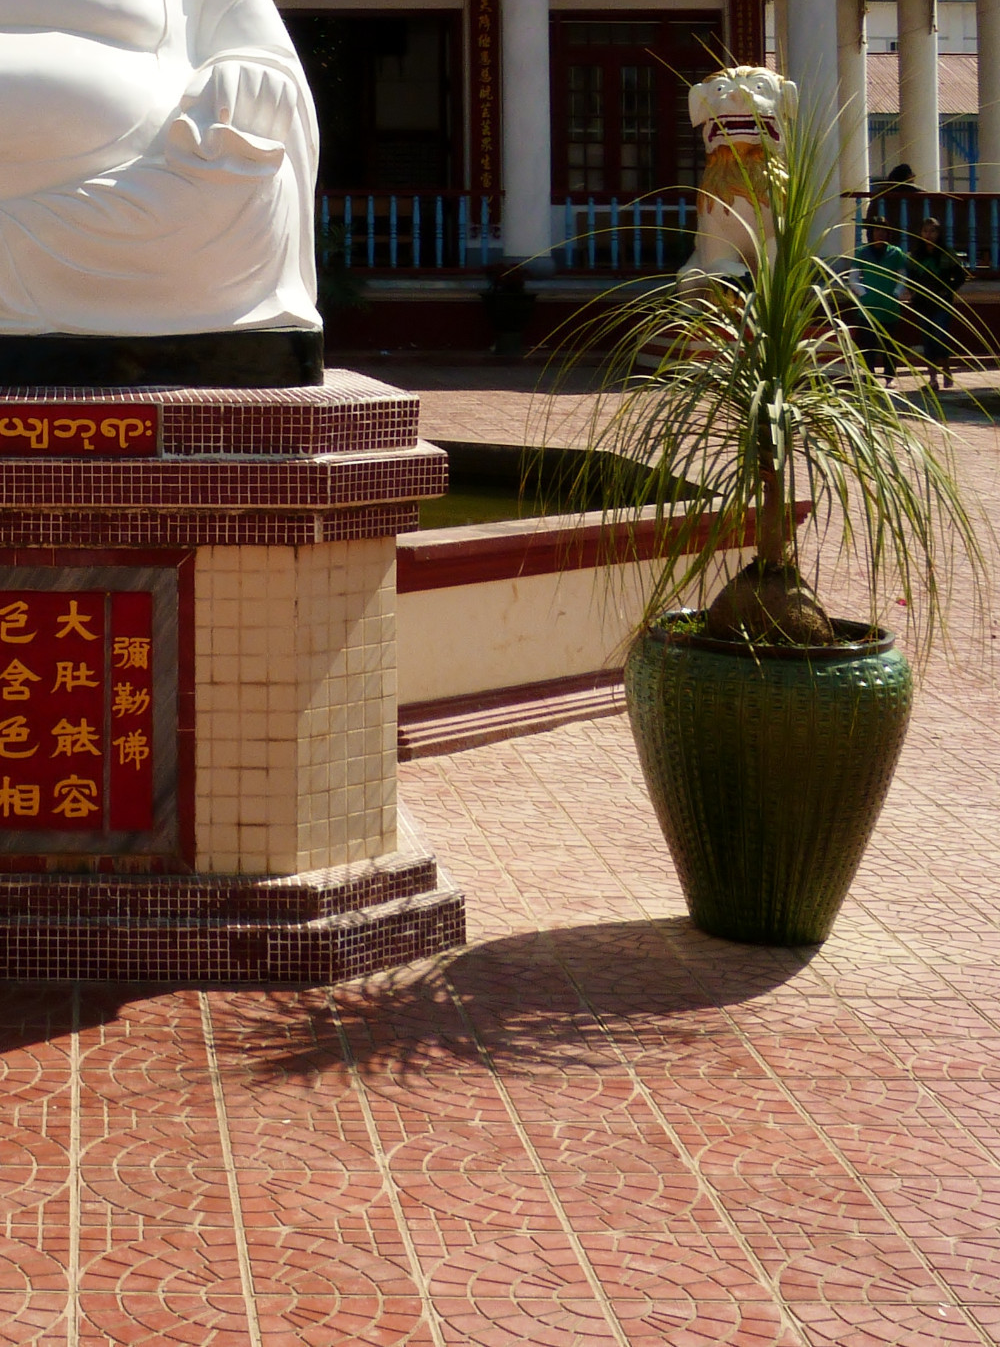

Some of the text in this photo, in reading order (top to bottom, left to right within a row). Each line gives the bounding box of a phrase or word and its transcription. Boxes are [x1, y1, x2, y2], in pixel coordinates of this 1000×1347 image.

[51, 599, 102, 818] 大肚能容
[111, 636, 151, 771] 彌勒佛
